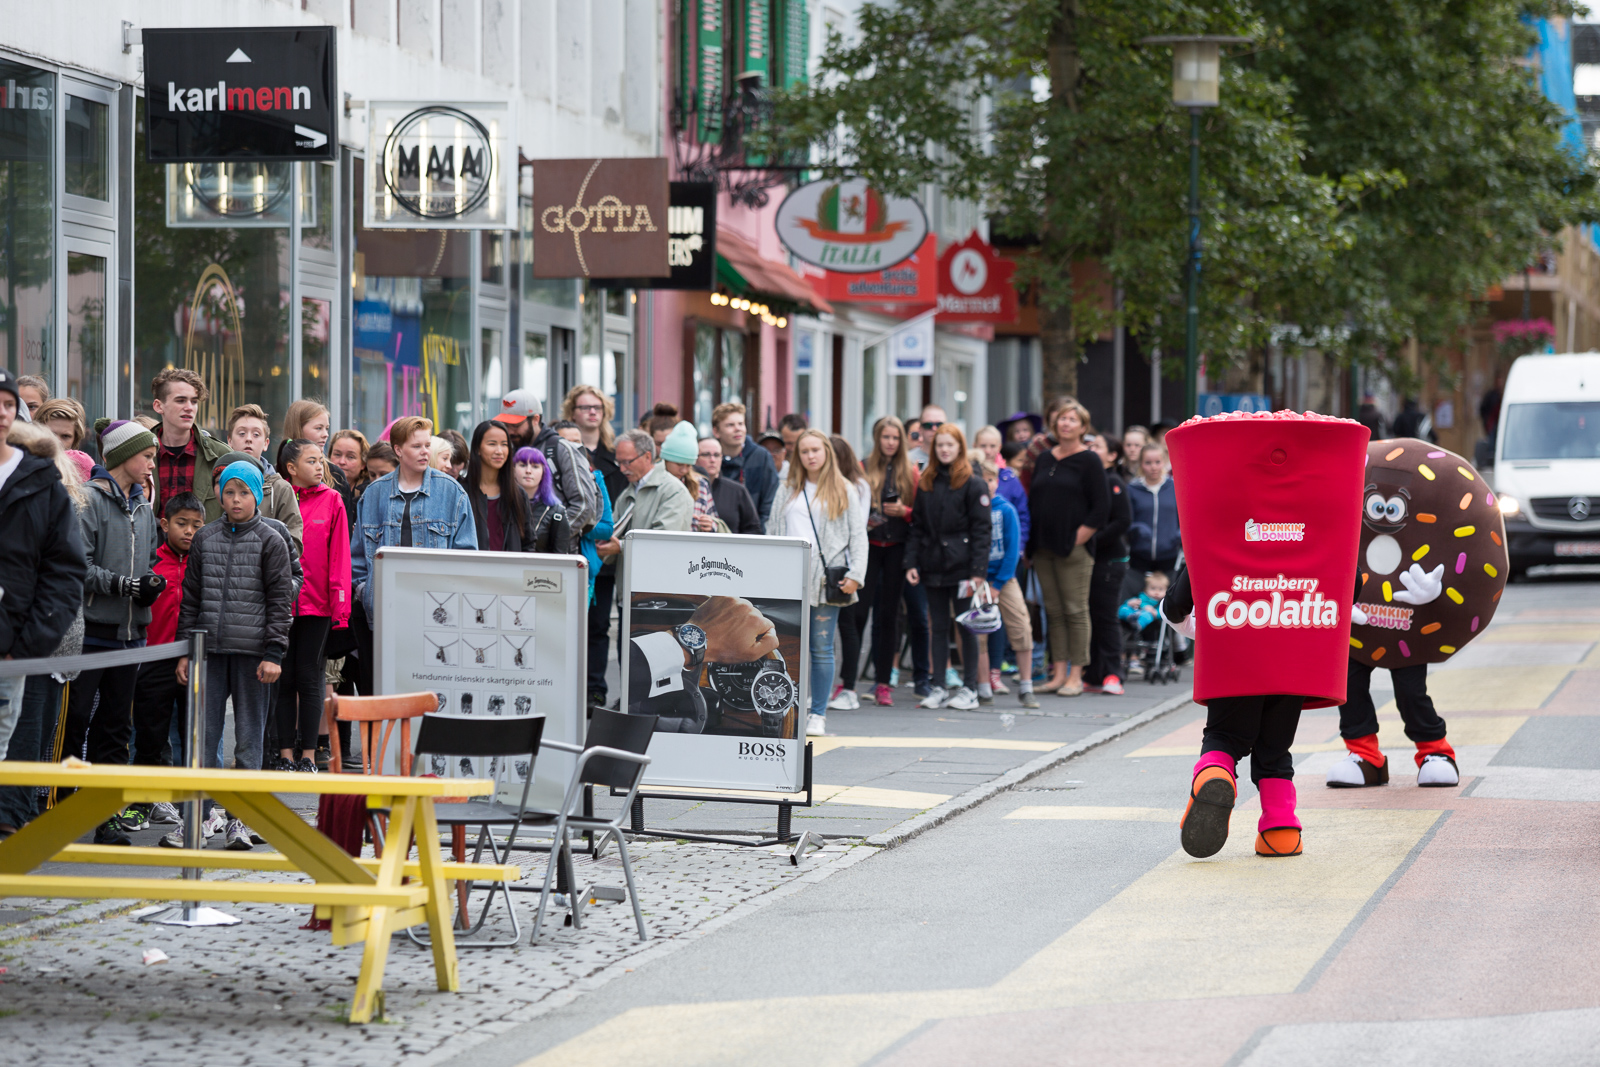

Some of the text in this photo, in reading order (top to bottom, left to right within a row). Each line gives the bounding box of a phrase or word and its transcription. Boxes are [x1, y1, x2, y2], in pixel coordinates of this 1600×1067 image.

[168, 80, 311, 112] karlmenn
[541, 195, 658, 233] GOTTA
[849, 280, 918, 296] adventures
[937, 294, 1001, 314] Marmot
[1261, 523, 1305, 532] DUNKIN'
[1261, 532, 1303, 540] DONUTS
[701, 556, 743, 578] Sigmundsson
[1231, 574, 1319, 593] Strawberry
[1206, 591, 1338, 627] Coolatta
[1360, 604, 1414, 620] DUNKIN'
[1366, 615, 1411, 630] ONUTS
[412, 672, 453, 682] Handunnir
[454, 674, 485, 684] íslenskir
[486, 676, 525, 687] skartgripir
[537, 679, 553, 687] silfri
[738, 741, 787, 758] BOSS
